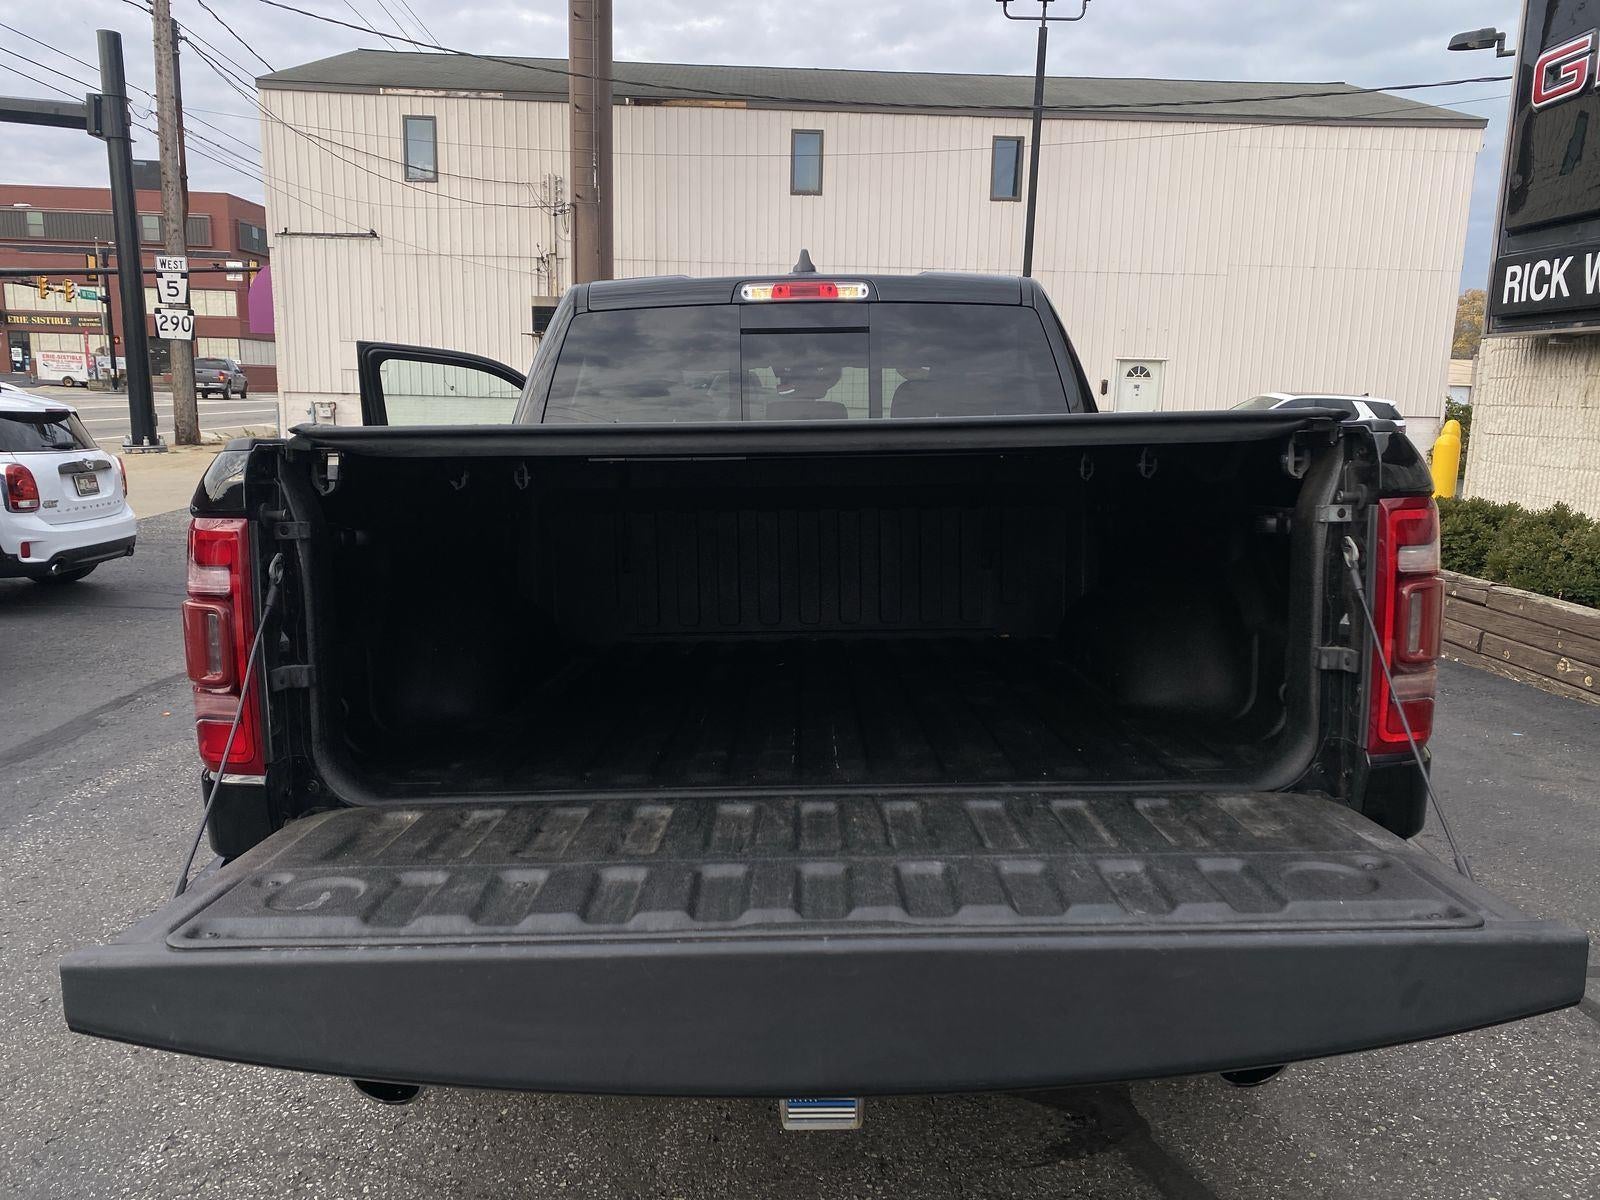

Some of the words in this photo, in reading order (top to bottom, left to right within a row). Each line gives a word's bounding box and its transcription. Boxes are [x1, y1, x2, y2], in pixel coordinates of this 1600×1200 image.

[1532, 28, 1600, 107] G
[160, 259, 184, 270] WEST
[1502, 255, 1574, 304] RICK
[166, 280, 180, 298] 5
[7, 315, 29, 324] ERIE
[31, 316, 72, 325] SISTIBLE
[159, 314, 192, 333] 290
